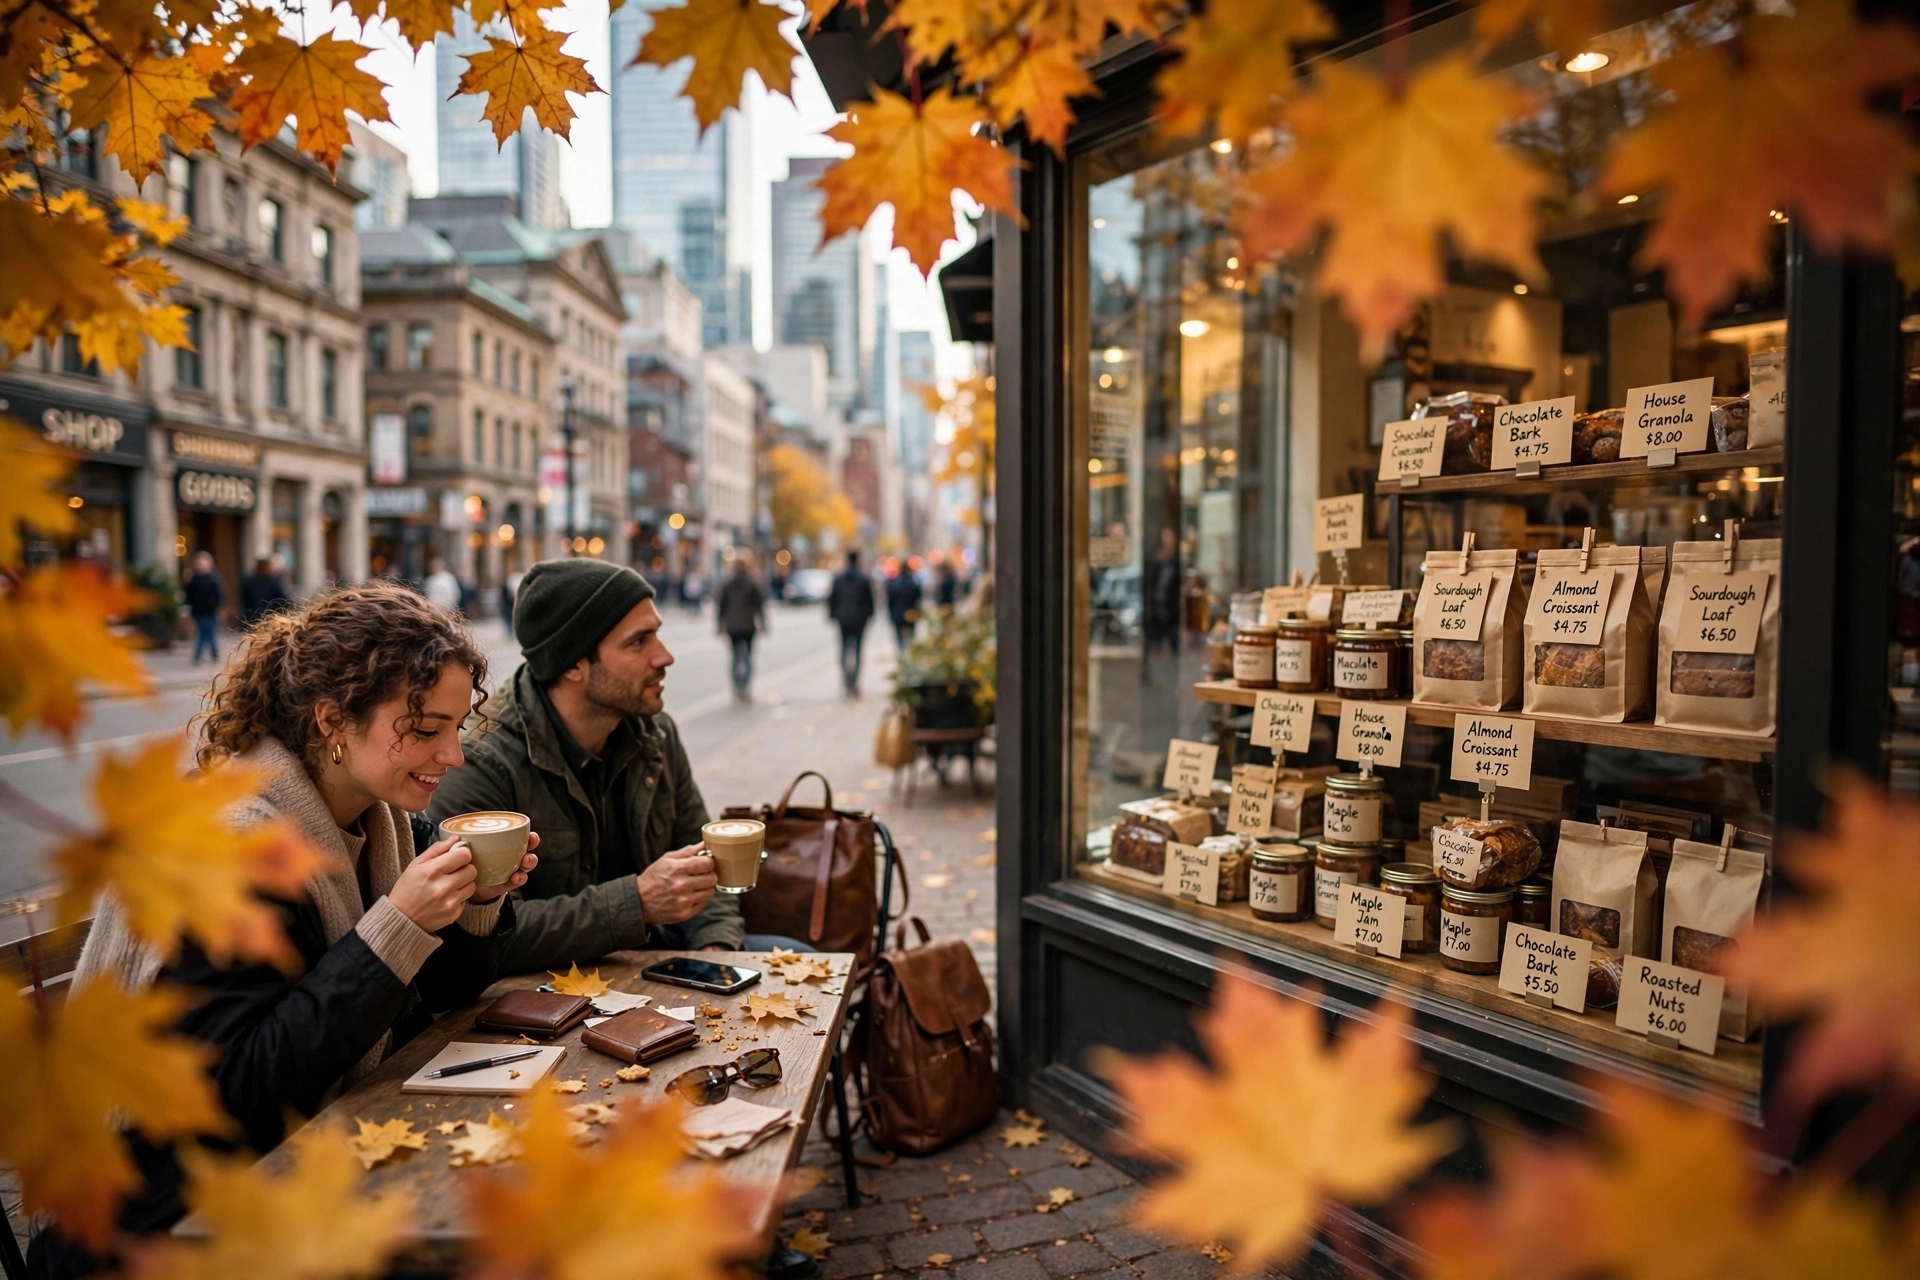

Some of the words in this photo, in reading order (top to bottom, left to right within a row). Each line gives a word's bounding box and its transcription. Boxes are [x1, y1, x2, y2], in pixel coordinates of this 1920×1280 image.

[1643, 392, 1687, 409] House
[1499, 405, 1563, 427] Chocolate
[1638, 409, 1694, 430] Granola
[42, 407, 124, 453] SHOP
[1509, 427, 1542, 442] Bark
[1646, 429, 1683, 446] $8.00
[1513, 442, 1549, 459] $4.75
[1433, 582, 1482, 601] Sourdough
[1552, 580, 1599, 597] Almond
[1689, 584, 1756, 606] Sourdough
[1442, 600, 1466, 614] Loaf
[1542, 598, 1600, 615] Croissant
[1702, 606, 1734, 623] Loaf
[1440, 618, 1466, 631] $6.50
[1553, 620, 1587, 635] $4.75
[1700, 627, 1737, 643] $6.50
[1343, 671, 1367, 683] $7.00
[1260, 698, 1304, 714] Chocolate
[1269, 713, 1292, 728] Bark
[1354, 707, 1386, 724] House
[1352, 725, 1392, 742] Granola
[1467, 720, 1513, 740] Almond
[1358, 743, 1384, 756] $8.00
[1461, 739, 1519, 758] Croissant
[1475, 760, 1509, 777] $4.75
[1251, 875, 1278, 892] Maple
[1255, 892, 1278, 904] $7.00
[1350, 891, 1383, 912] Maple
[1356, 909, 1379, 927] Jam
[1355, 927, 1383, 944] $7.00
[1442, 917, 1471, 937] Maple
[1445, 935, 1471, 952] $7.00
[1515, 933, 1577, 961] Chocolate
[1526, 954, 1559, 978] Bark
[1524, 974, 1559, 995] $5.50
[1639, 966, 1702, 997] Roasted
[1648, 990, 1686, 1015] Nuts
[1647, 1011, 1687, 1034] $6.00
